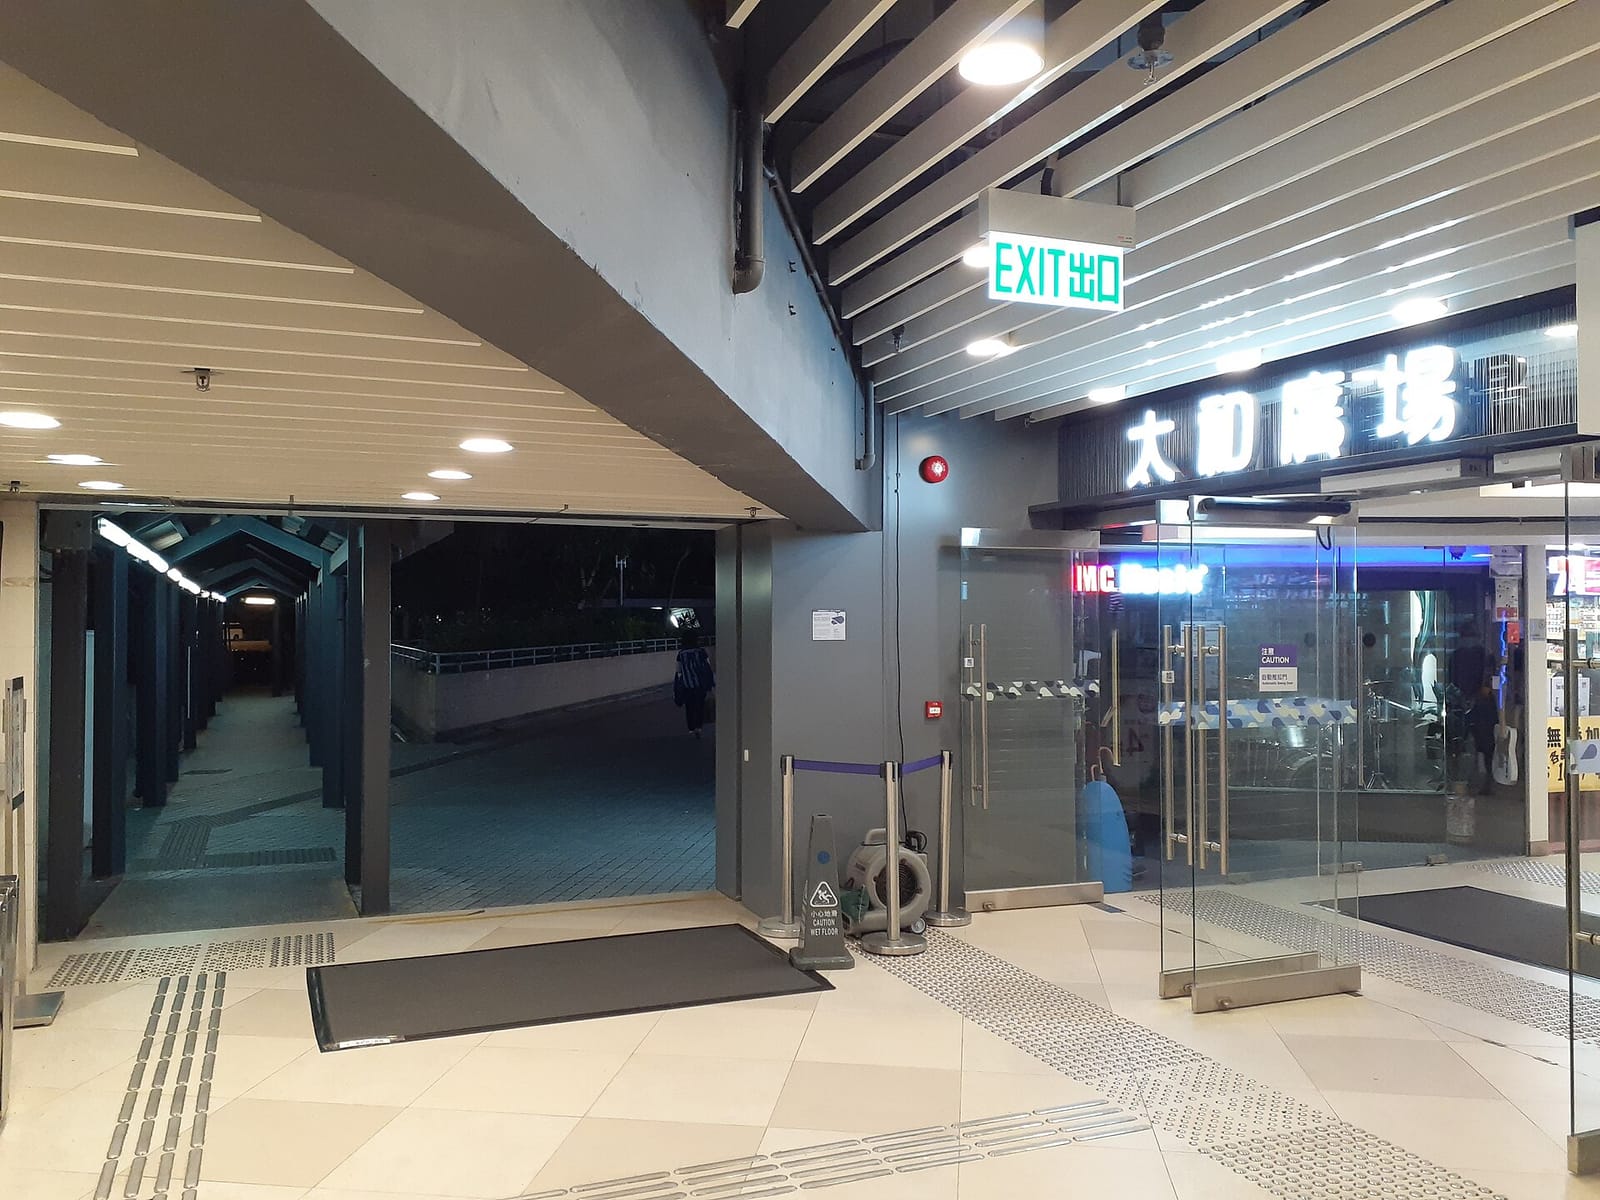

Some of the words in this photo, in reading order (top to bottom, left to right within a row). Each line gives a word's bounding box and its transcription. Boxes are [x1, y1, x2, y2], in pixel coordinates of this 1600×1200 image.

[996, 242, 1066, 298] EXIT
[1069, 252, 1119, 304] 出口
[812, 918, 836, 926] CAUTION
[810, 928, 820, 936] WET
[821, 927, 839, 936] FLOOR
